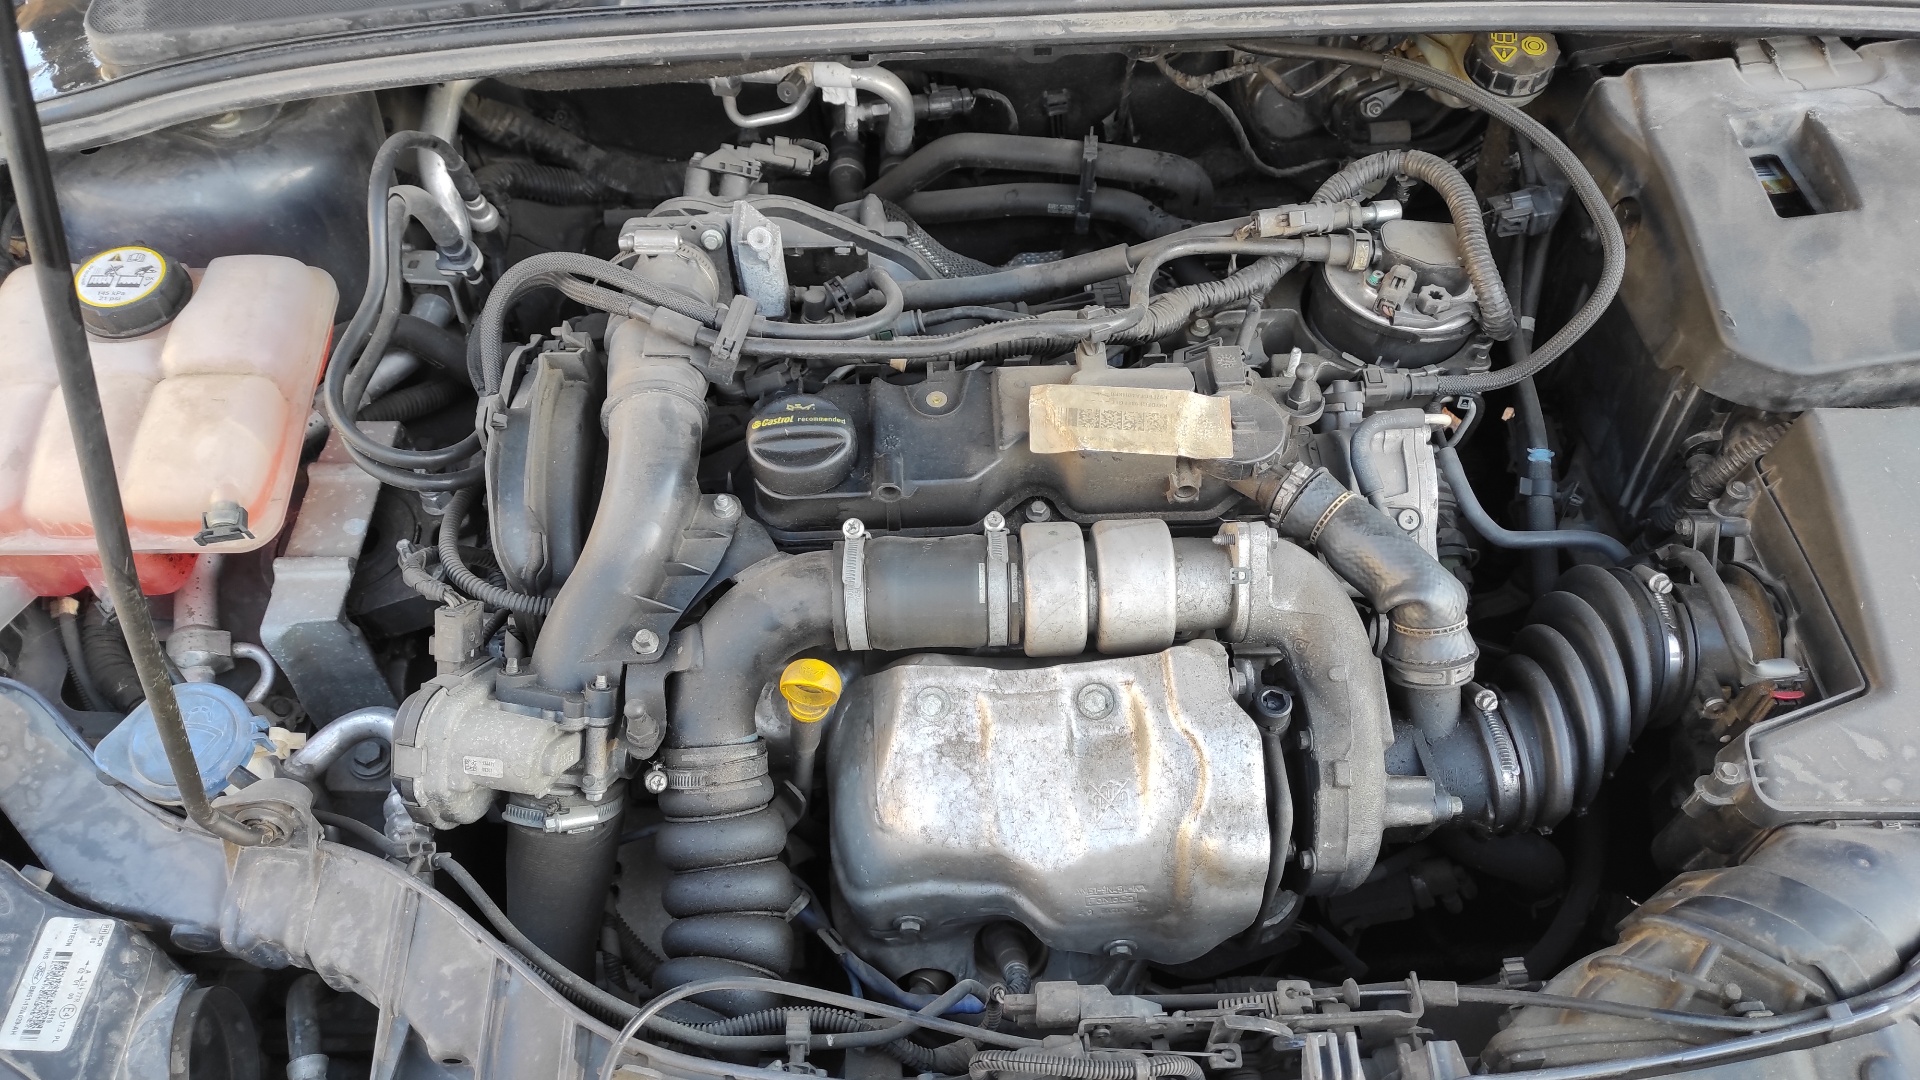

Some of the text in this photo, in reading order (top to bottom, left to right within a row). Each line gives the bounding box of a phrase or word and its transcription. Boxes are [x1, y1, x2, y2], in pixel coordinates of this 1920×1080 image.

[761, 415, 846, 427] Castrol recommended
[65, 923, 80, 947] VISTEON
